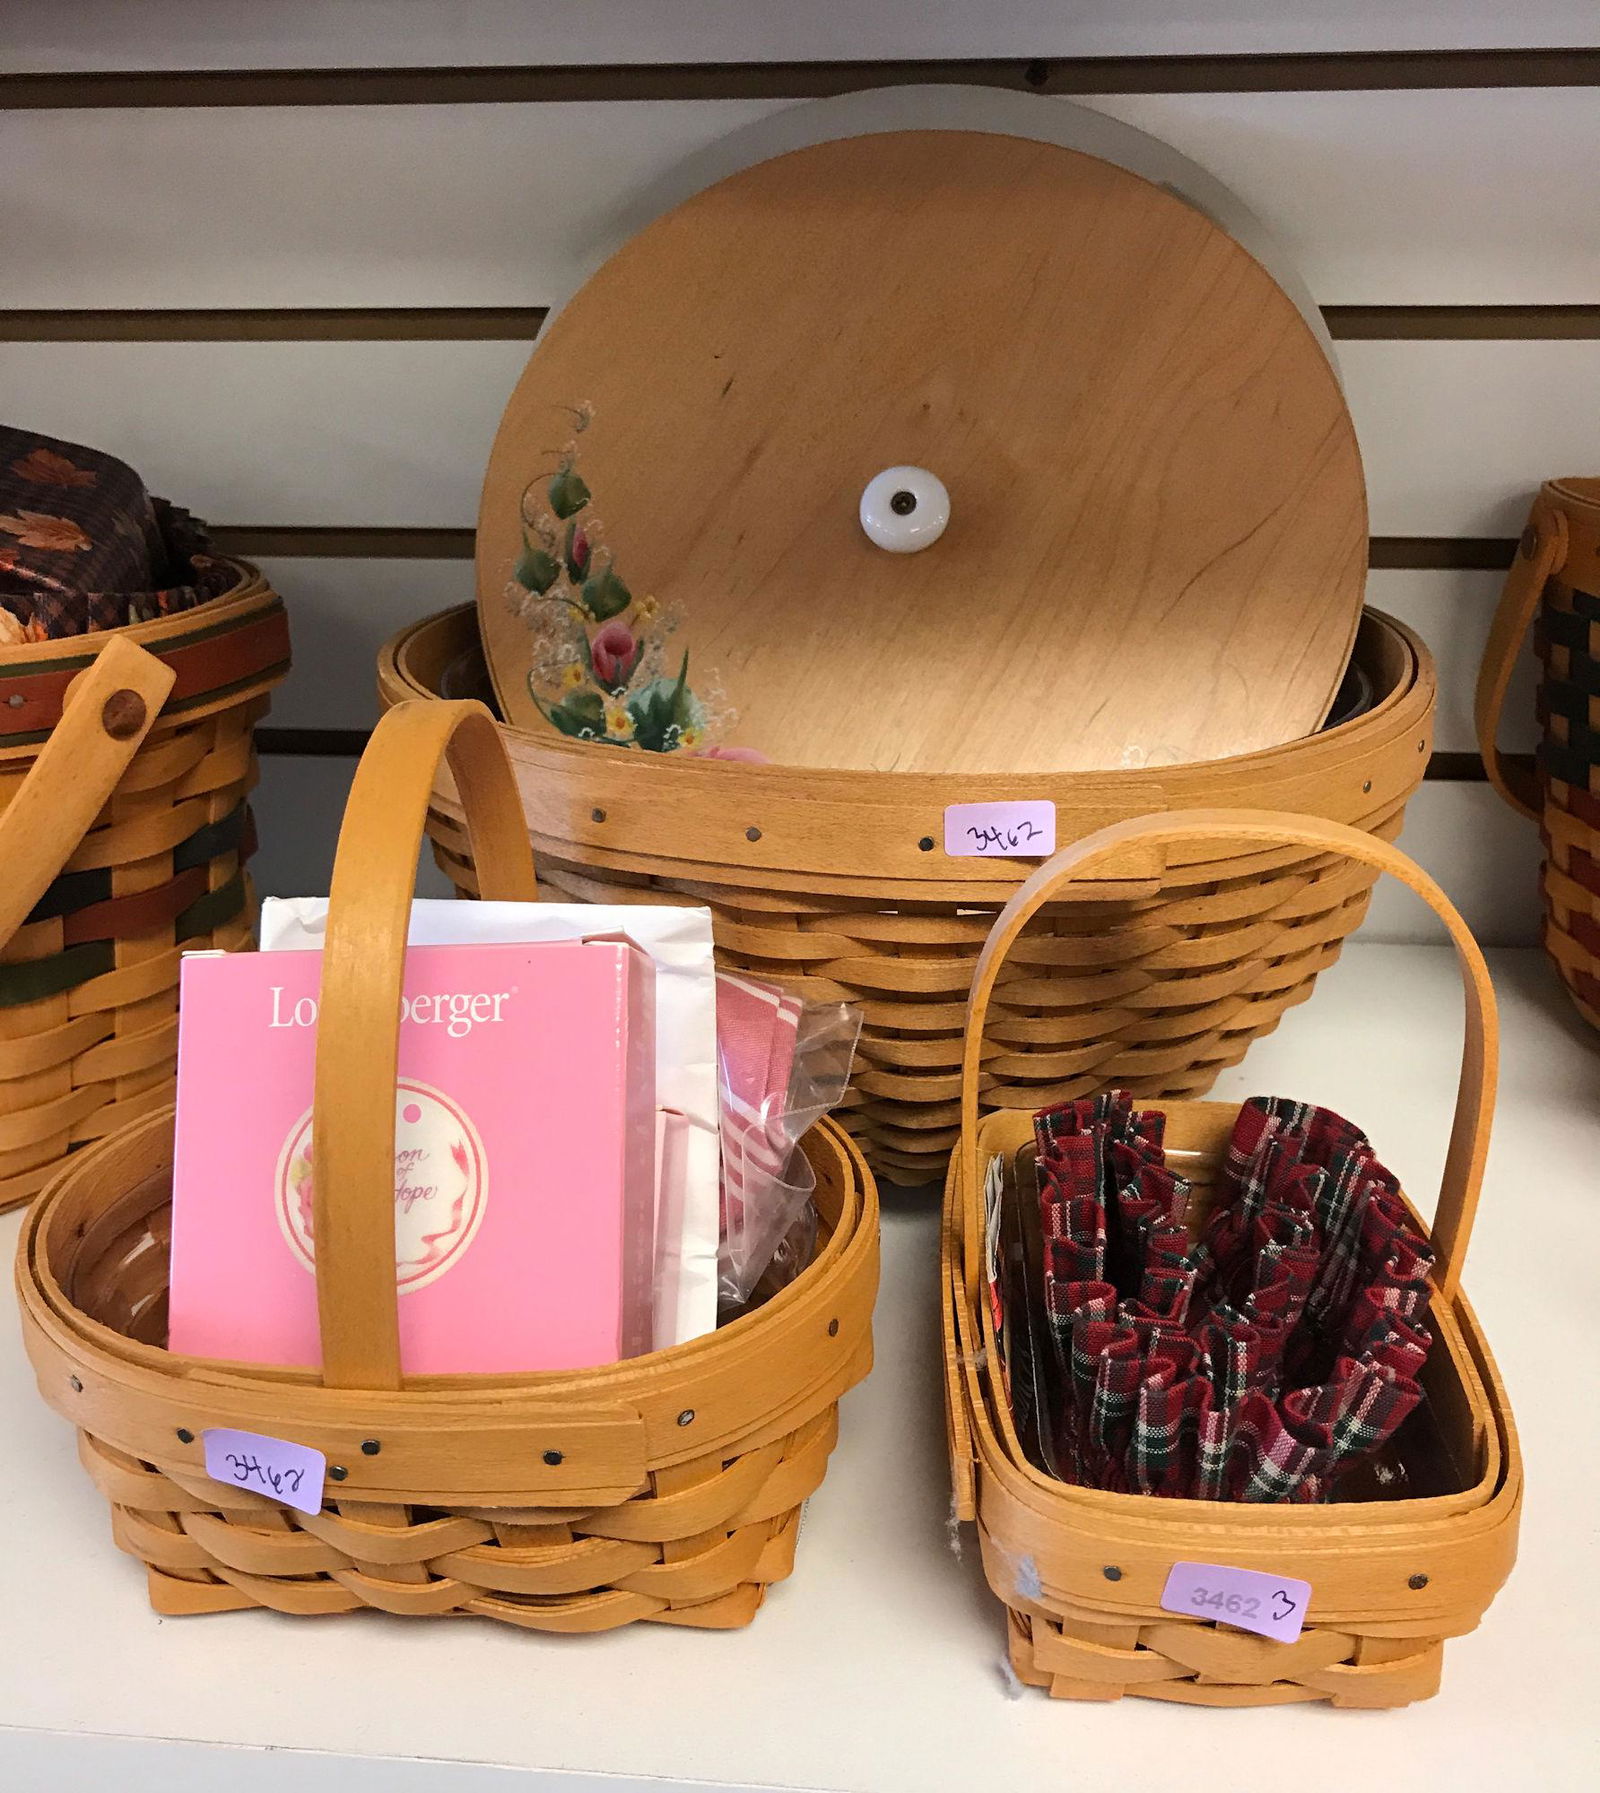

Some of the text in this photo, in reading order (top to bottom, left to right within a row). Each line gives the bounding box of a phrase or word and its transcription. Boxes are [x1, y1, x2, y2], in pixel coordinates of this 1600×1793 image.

[967, 821, 1043, 851] 3462
[396, 1163, 414, 1180] of
[225, 1454, 305, 1495] 3462
[1191, 1587, 1296, 1621] 3462 3
